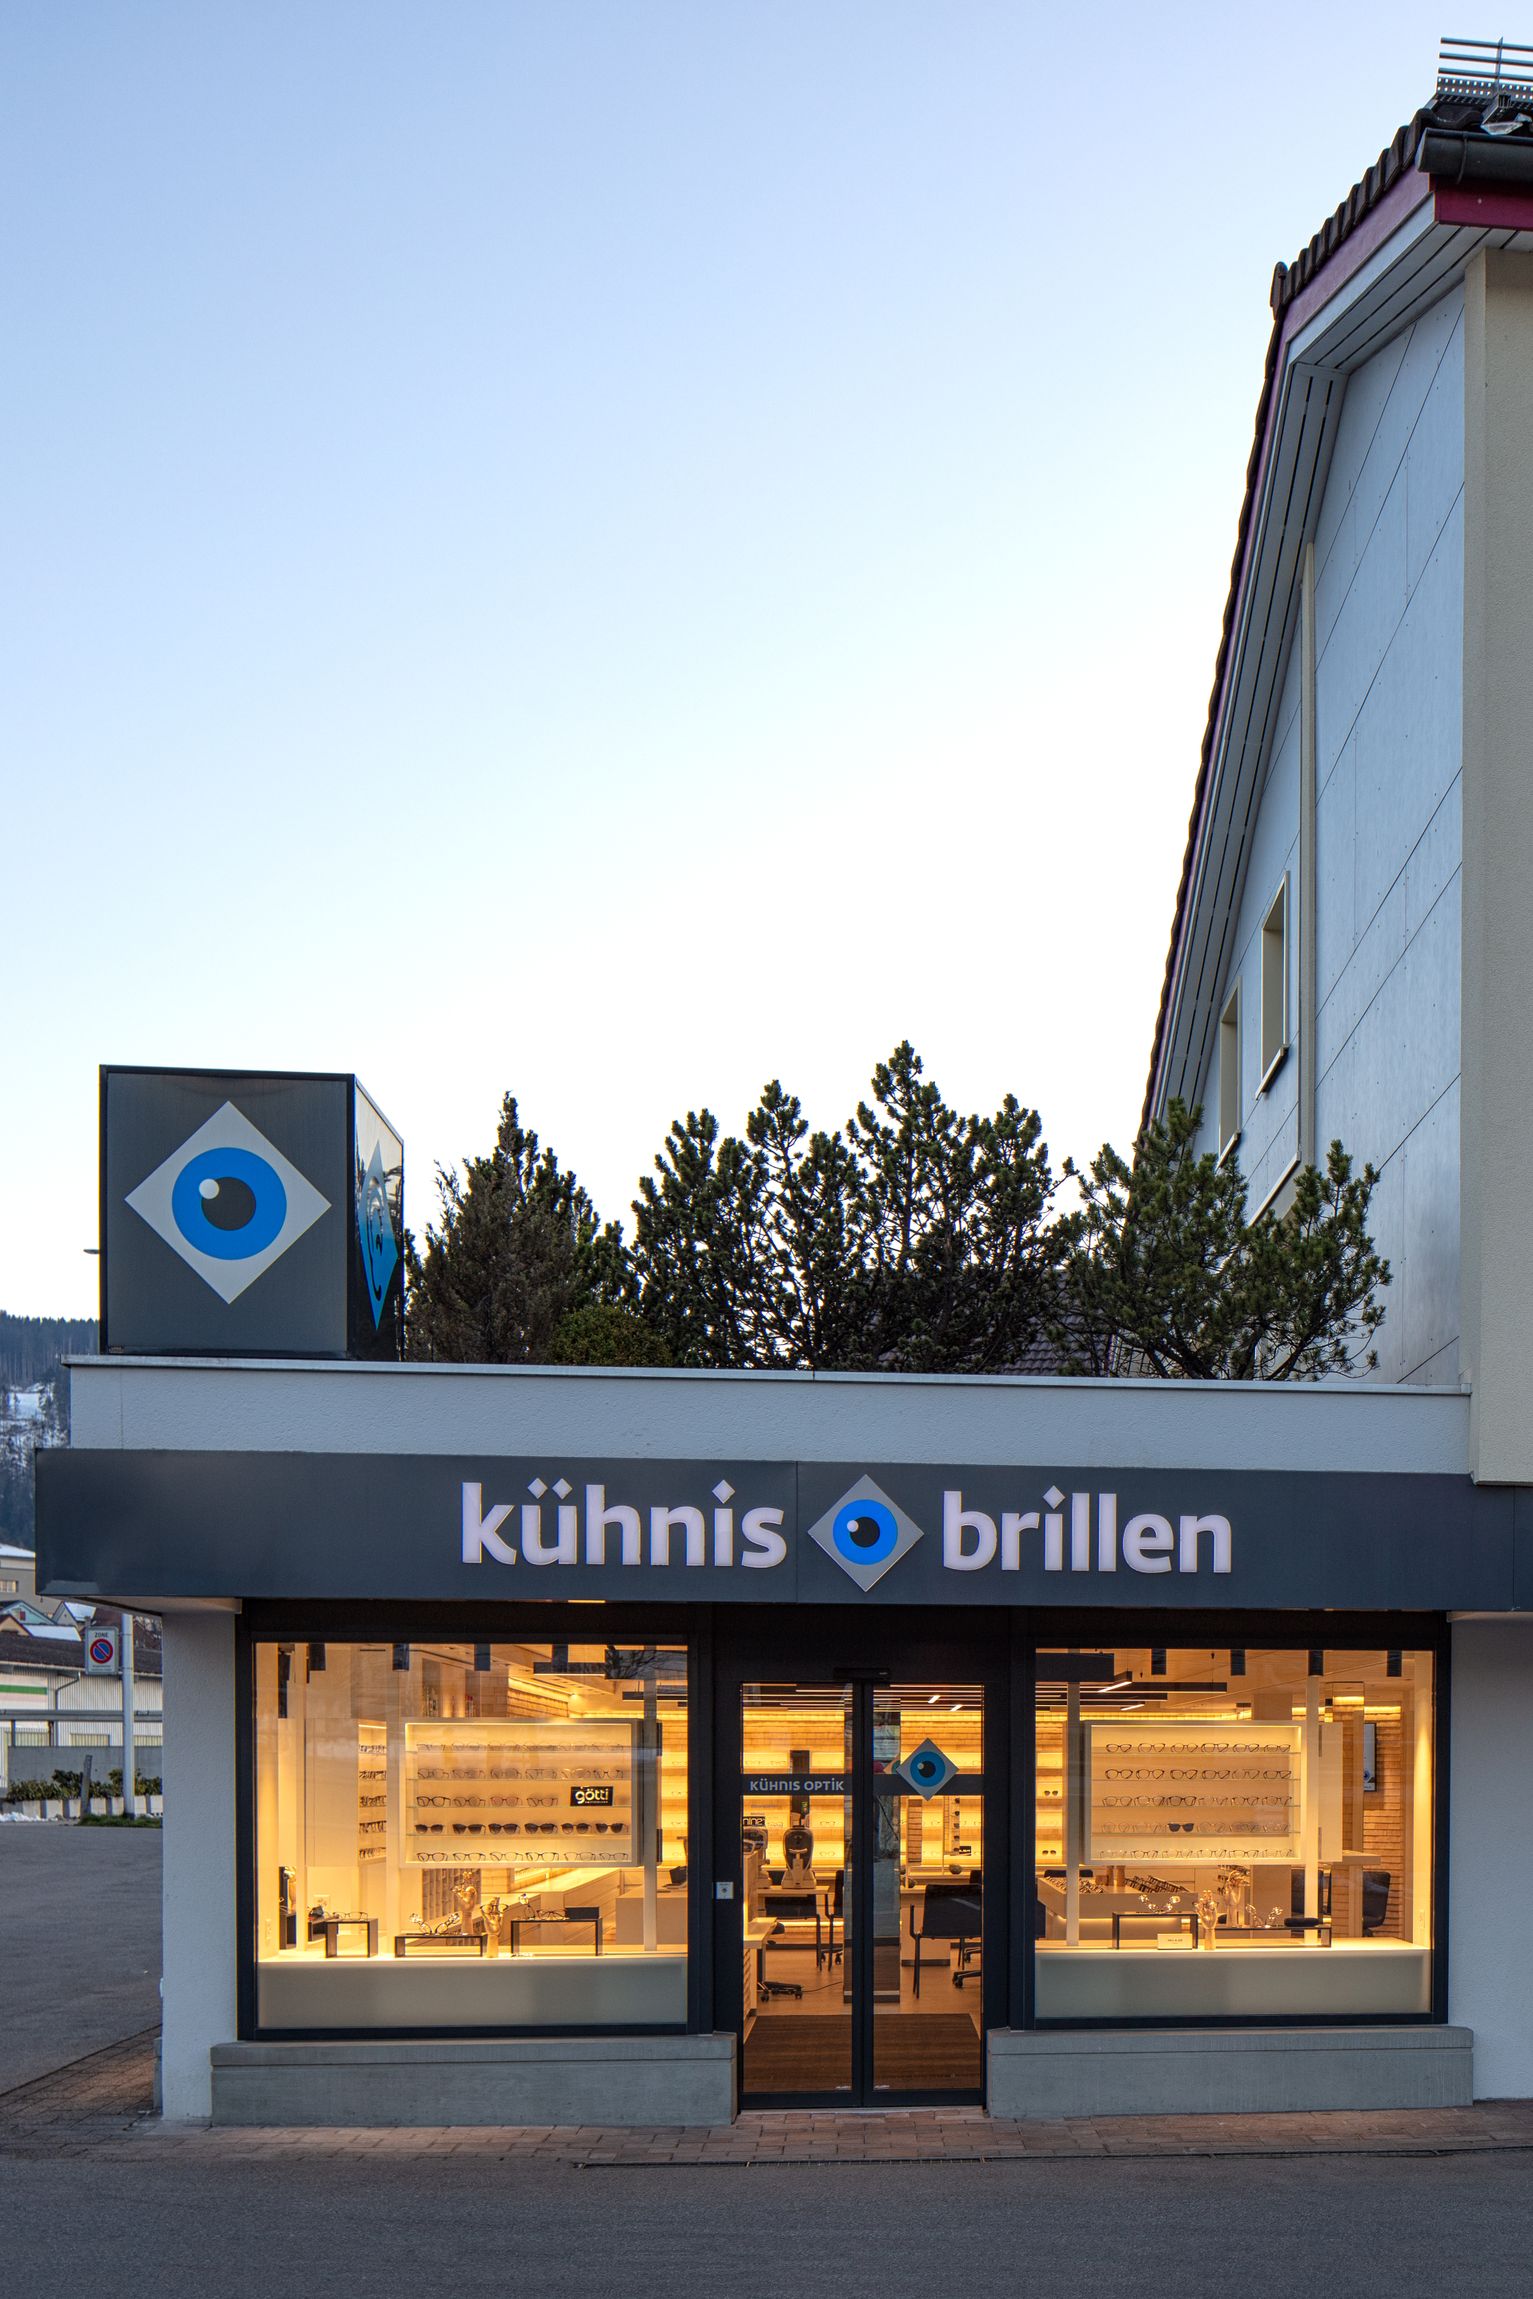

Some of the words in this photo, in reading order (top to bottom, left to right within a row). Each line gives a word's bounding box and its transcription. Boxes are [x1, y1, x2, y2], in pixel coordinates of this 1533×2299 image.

[461, 1477, 787, 1569] kühnis
[943, 1485, 1232, 1574] brillen
[749, 1777, 801, 1792] KÜHNIS
[575, 1788, 609, 1805] götti
